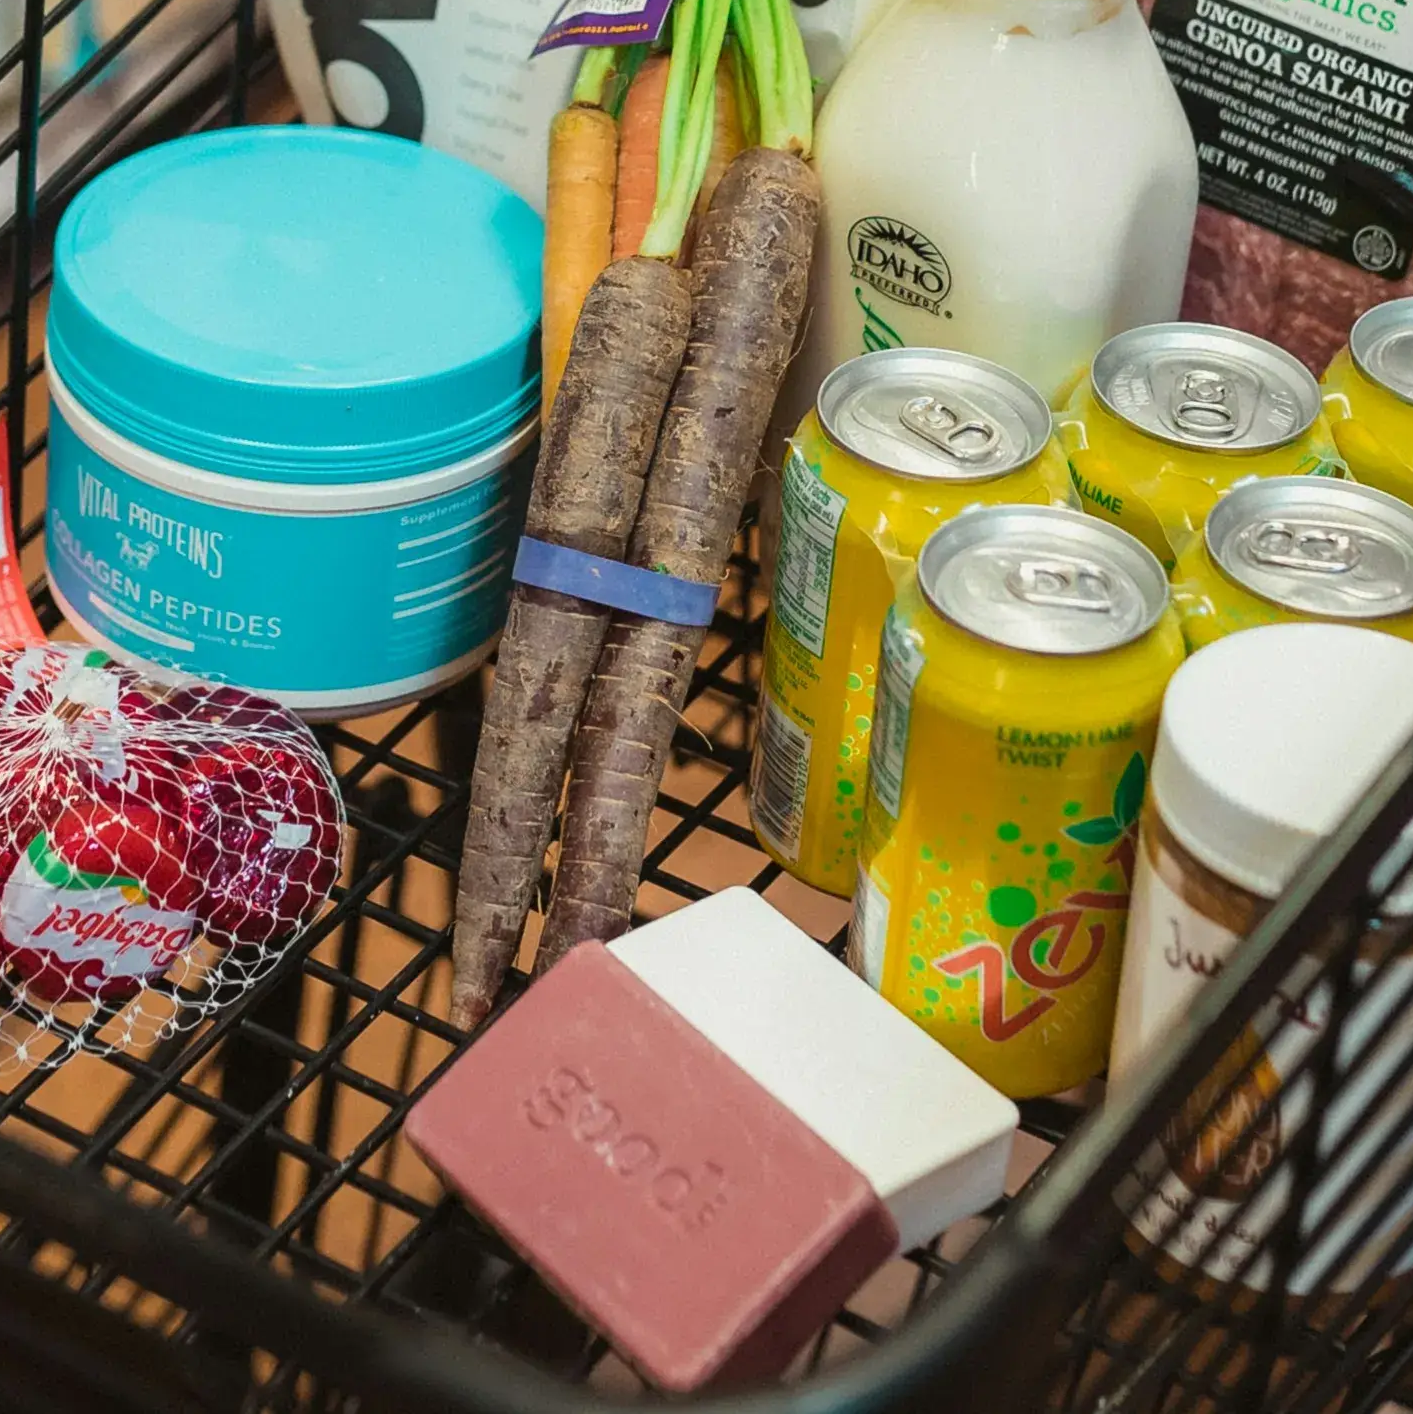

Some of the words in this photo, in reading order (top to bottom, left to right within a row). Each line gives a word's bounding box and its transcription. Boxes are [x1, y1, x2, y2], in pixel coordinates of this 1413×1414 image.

[1293, 11, 1313, 24] THE
[1313, 17, 1342, 37] MEAT
[1345, 29, 1361, 42] WE
[1167, 33, 1205, 59] nitrites
[1206, 53, 1219, 65] or
[1219, 59, 1261, 84] nitrates
[1262, 77, 1297, 99] added
[1297, 91, 1333, 114] except
[1335, 104, 1352, 119] for
[1353, 112, 1385, 134] those
[1186, 19, 1284, 76] GENOA
[1291, 61, 1410, 124] SALAMI
[1307, 43, 1413, 97] ORGANIC
[1182, 77, 1247, 114] ANTIBIOTICS
[1293, 124, 1355, 156] HUMANELY
[1199, 65, 1211, 77] in
[1212, 70, 1231, 86] sea
[1232, 78, 1252, 95] salt
[1253, 88, 1275, 104] and
[1275, 96, 1321, 123] cultured
[1321, 115, 1355, 139] celery
[1355, 127, 1384, 148] juice
[1219, 108, 1261, 134] GLUTEN
[1261, 127, 1269, 139] &
[1270, 130, 1310, 154] CASEIN
[1311, 146, 1337, 166] FREE
[1219, 129, 1247, 148] KEEP
[1246, 141, 1326, 182] REFRIGERATED
[1197, 142, 1226, 167] NET
[1226, 154, 1251, 179] WT.
[1253, 168, 1266, 184] 4
[1267, 171, 1289, 194] OZ.
[1292, 183, 1338, 216] (113g)
[857, 237, 944, 294] IDAHO
[860, 269, 930, 309] PREFERRED
[77, 463, 122, 523] VITAL
[127, 501, 225, 579] PROTEINS
[399, 492, 482, 527] Supplement
[1082, 480, 1123, 515] LIME
[51, 507, 142, 603] COLLAGEN
[149, 588, 283, 639] PEPTIDES
[996, 724, 1082, 749] LEMON
[1087, 722, 1134, 746] LIME
[996, 747, 1068, 769] TWIST
